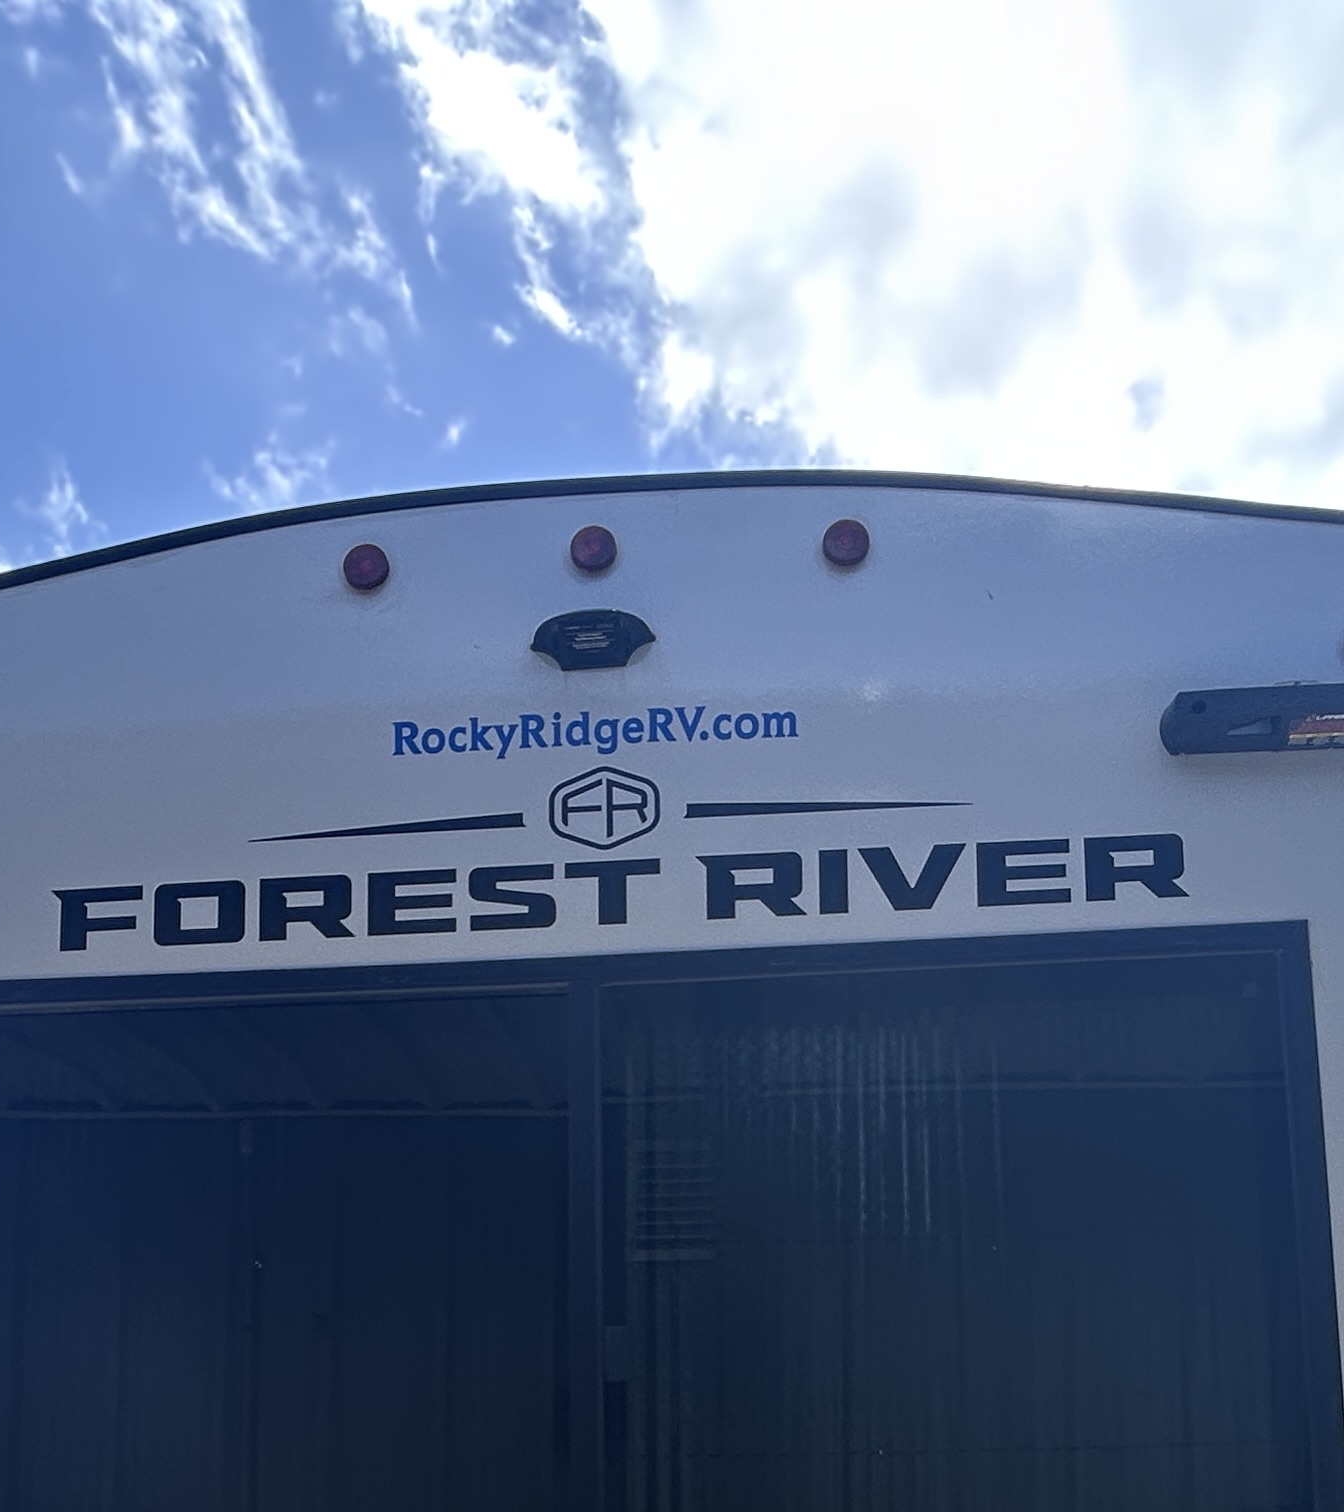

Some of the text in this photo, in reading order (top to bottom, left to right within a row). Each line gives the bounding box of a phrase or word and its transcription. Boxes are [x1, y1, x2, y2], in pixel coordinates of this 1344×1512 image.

[392, 706, 799, 760] RockyRidgeRV.com
[52, 834, 1191, 953] FOREST RIVER
